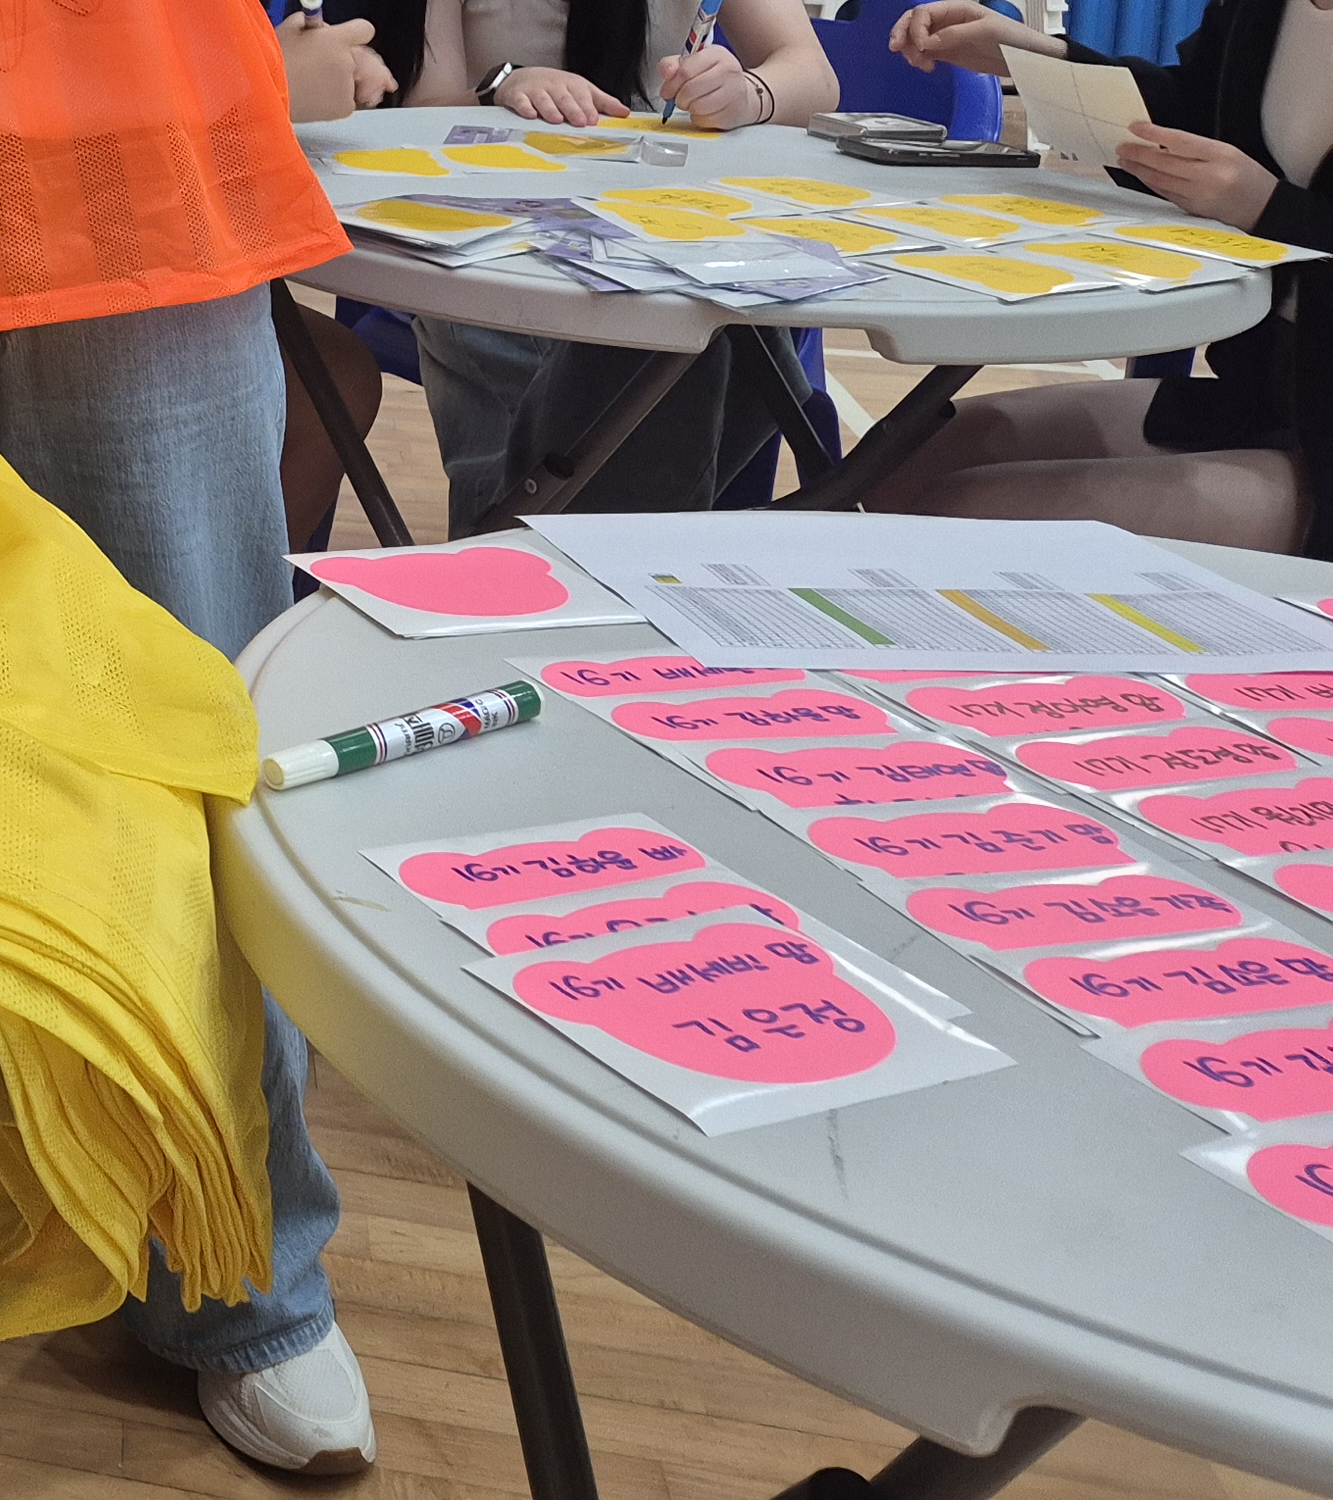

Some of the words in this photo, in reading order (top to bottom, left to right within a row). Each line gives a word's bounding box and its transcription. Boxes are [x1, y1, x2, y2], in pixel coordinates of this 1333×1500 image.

[651, 714, 719, 731] 16기
[756, 765, 850, 786] 16기
[854, 836, 942, 857] 16기
[942, 828, 1066, 853] 김준기
[1065, 823, 1116, 846] 맘
[451, 864, 521, 883] 16기
[947, 900, 1036, 926] 16기
[1043, 896, 1161, 924] 김소은
[549, 975, 626, 1000] 16기
[764, 940, 821, 965] 맘
[1069, 973, 1165, 998] 16기
[1163, 960, 1290, 995] 김소은
[672, 999, 866, 1052] 김은정
[1182, 1056, 1284, 1088] 16기
